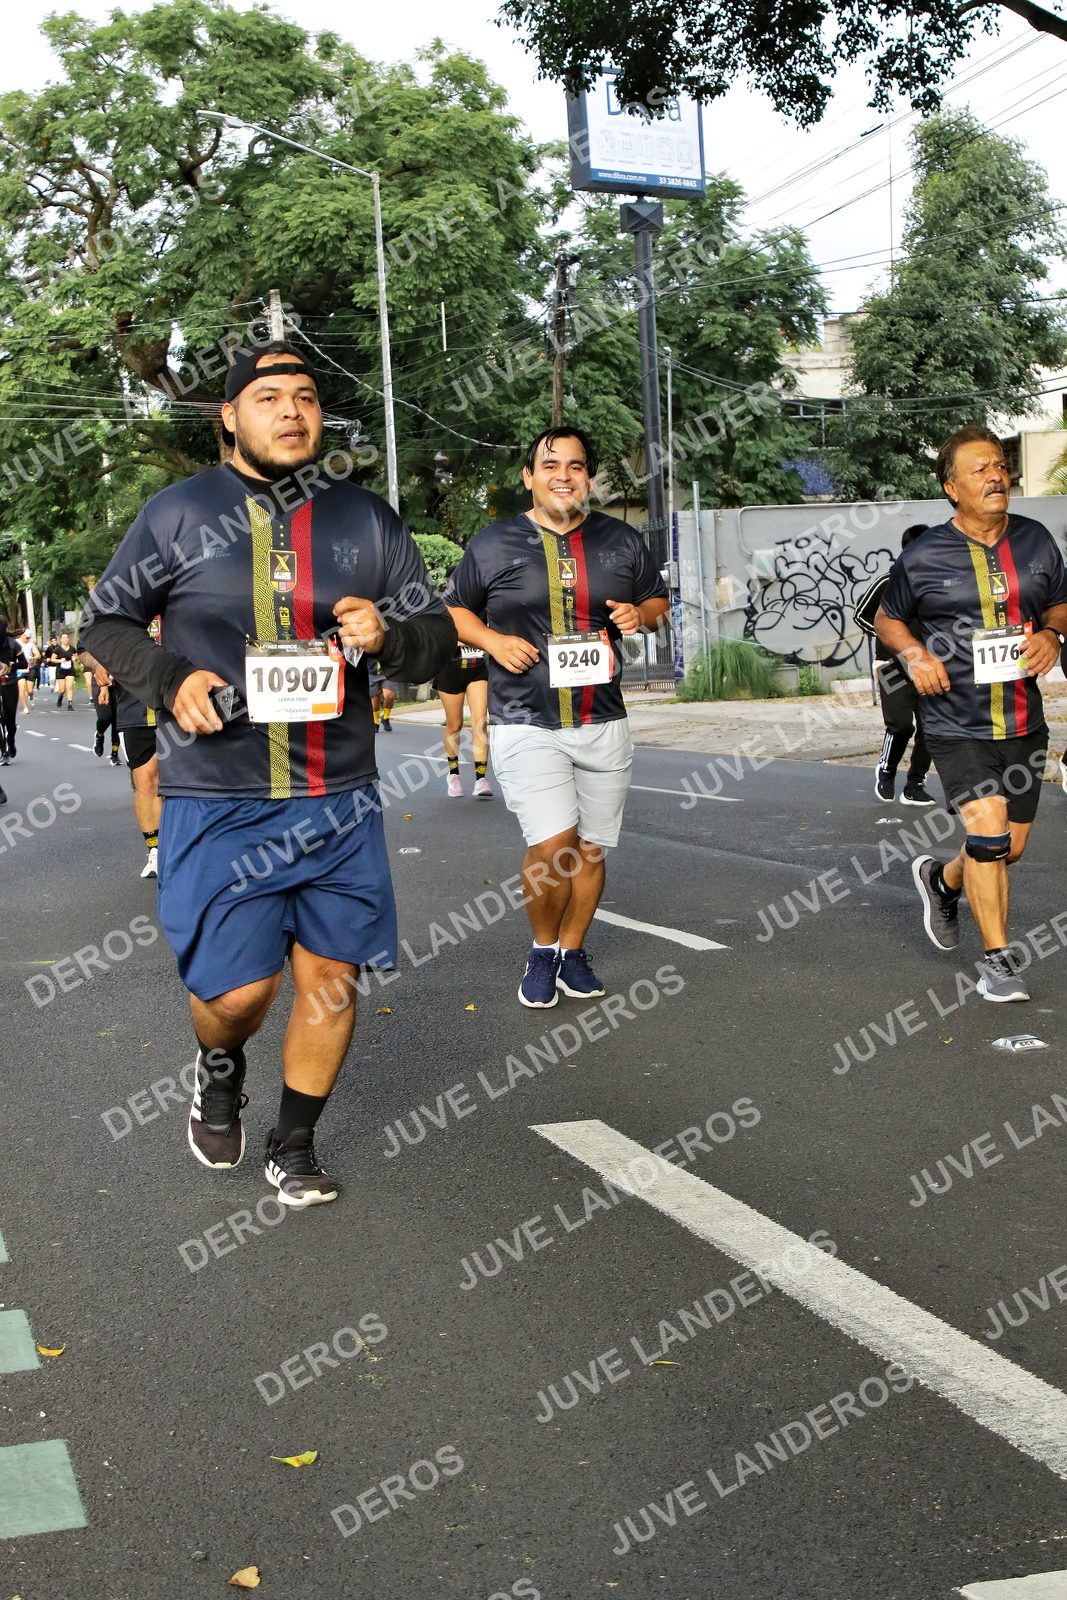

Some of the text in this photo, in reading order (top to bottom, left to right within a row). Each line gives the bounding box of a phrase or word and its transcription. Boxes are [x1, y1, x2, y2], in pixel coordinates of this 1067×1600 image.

[775, 532, 834, 556] TOY
[557, 648, 600, 669] 9240
[977, 643, 1025, 665] 1176
[252, 666, 334, 693] 10907
